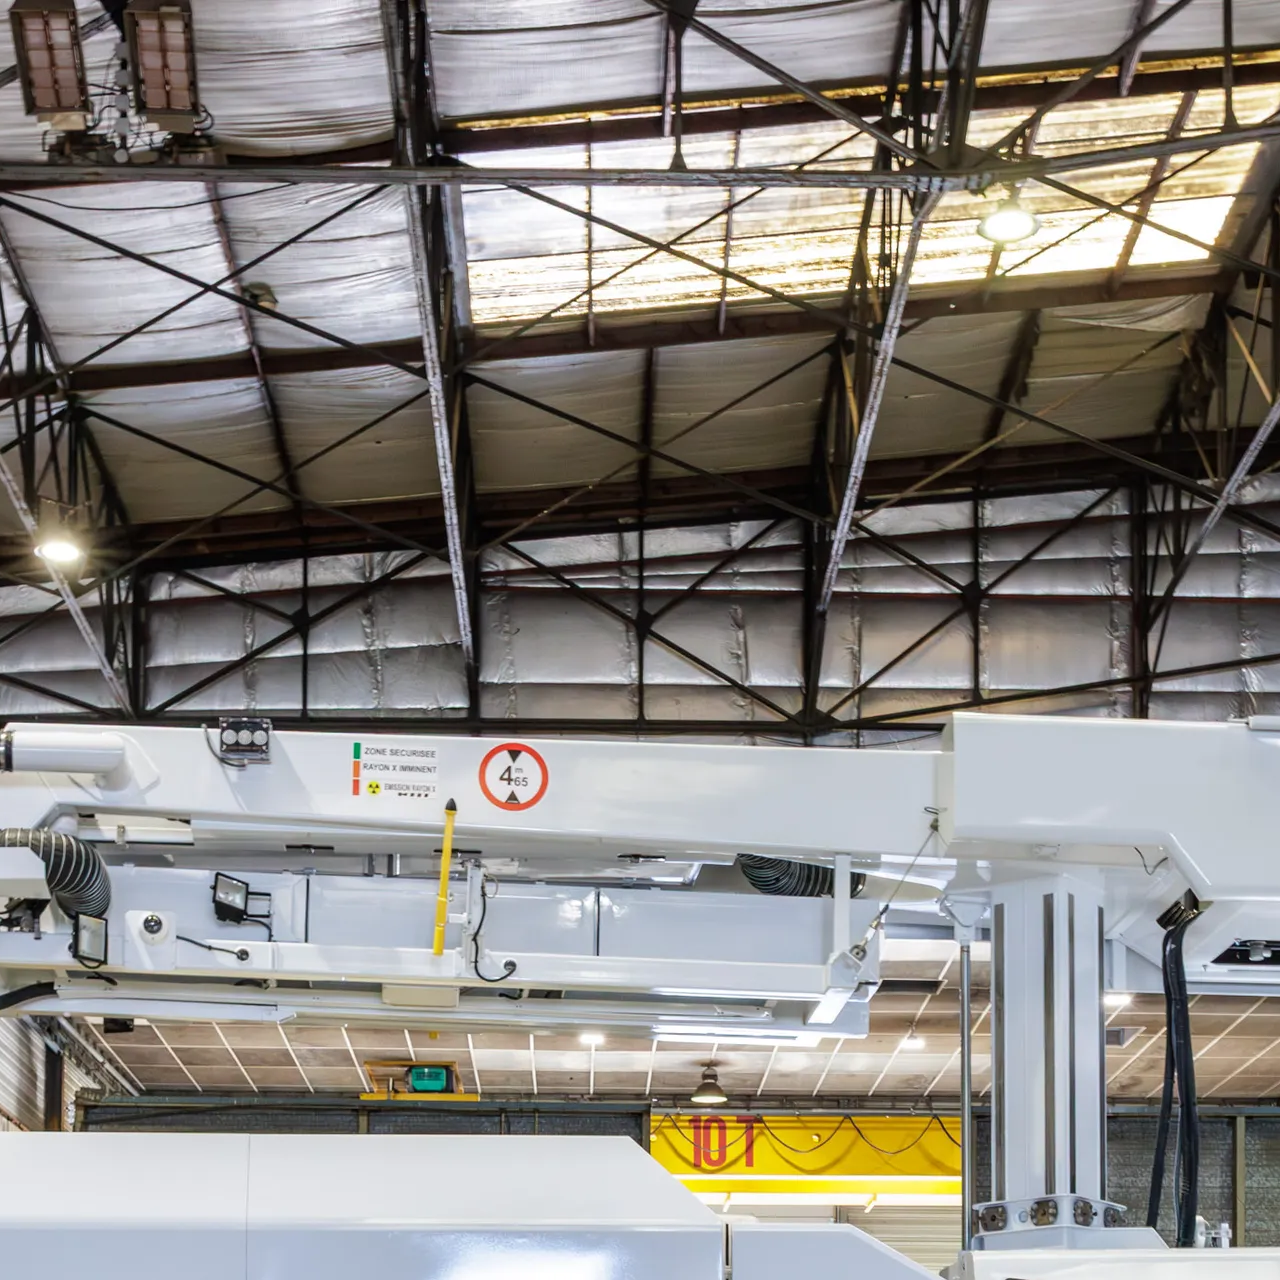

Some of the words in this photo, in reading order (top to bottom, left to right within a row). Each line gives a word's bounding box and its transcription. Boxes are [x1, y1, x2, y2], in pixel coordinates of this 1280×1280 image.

[364, 747, 387, 756] ZONE
[389, 748, 436, 758] SECURISEE
[363, 762, 390, 771] RAYON
[392, 764, 397, 772] X
[399, 764, 437, 774] IMMINENT
[499, 765, 514, 786] 4
[514, 776, 528, 787] 65
[688, 1114, 727, 1168] 10
[736, 1114, 762, 1168] T
